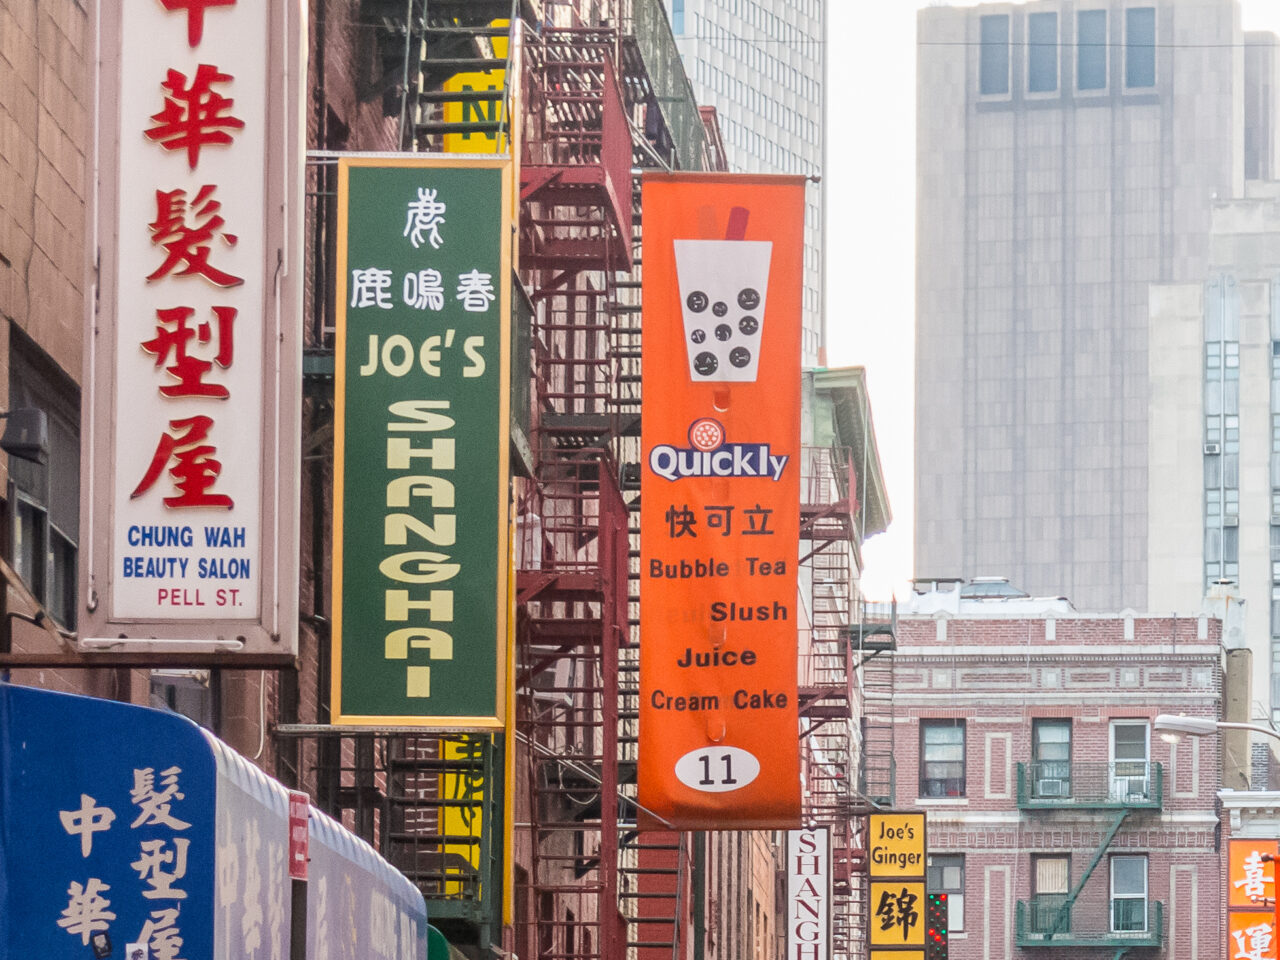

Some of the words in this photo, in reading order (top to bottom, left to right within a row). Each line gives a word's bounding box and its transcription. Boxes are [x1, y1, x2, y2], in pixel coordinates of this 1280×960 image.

[351, 268, 495, 313] 鹿鳴春
[360, 329, 486, 377] JOE'S
[650, 443, 789, 482] Quickly
[665, 504, 774, 538] 快可立
[127, 525, 193, 547] CHUNG
[206, 525, 245, 547] WAH
[379, 400, 457, 697] SHANGHAI
[123, 557, 188, 579] BEAUTY
[198, 557, 251, 579] SALON
[650, 557, 729, 579] Bubble
[746, 557, 787, 576] Tea
[157, 588, 204, 606] PELL
[215, 588, 243, 606] ST.
[711, 601, 788, 622] Slush
[677, 647, 757, 668] Juice
[651, 689, 719, 711] Cream
[733, 689, 788, 710] Cake
[698, 754, 738, 785] 11
[880, 821, 914, 840] Joe's
[872, 847, 922, 869] Ginger
[56, 794, 116, 947] 中華
